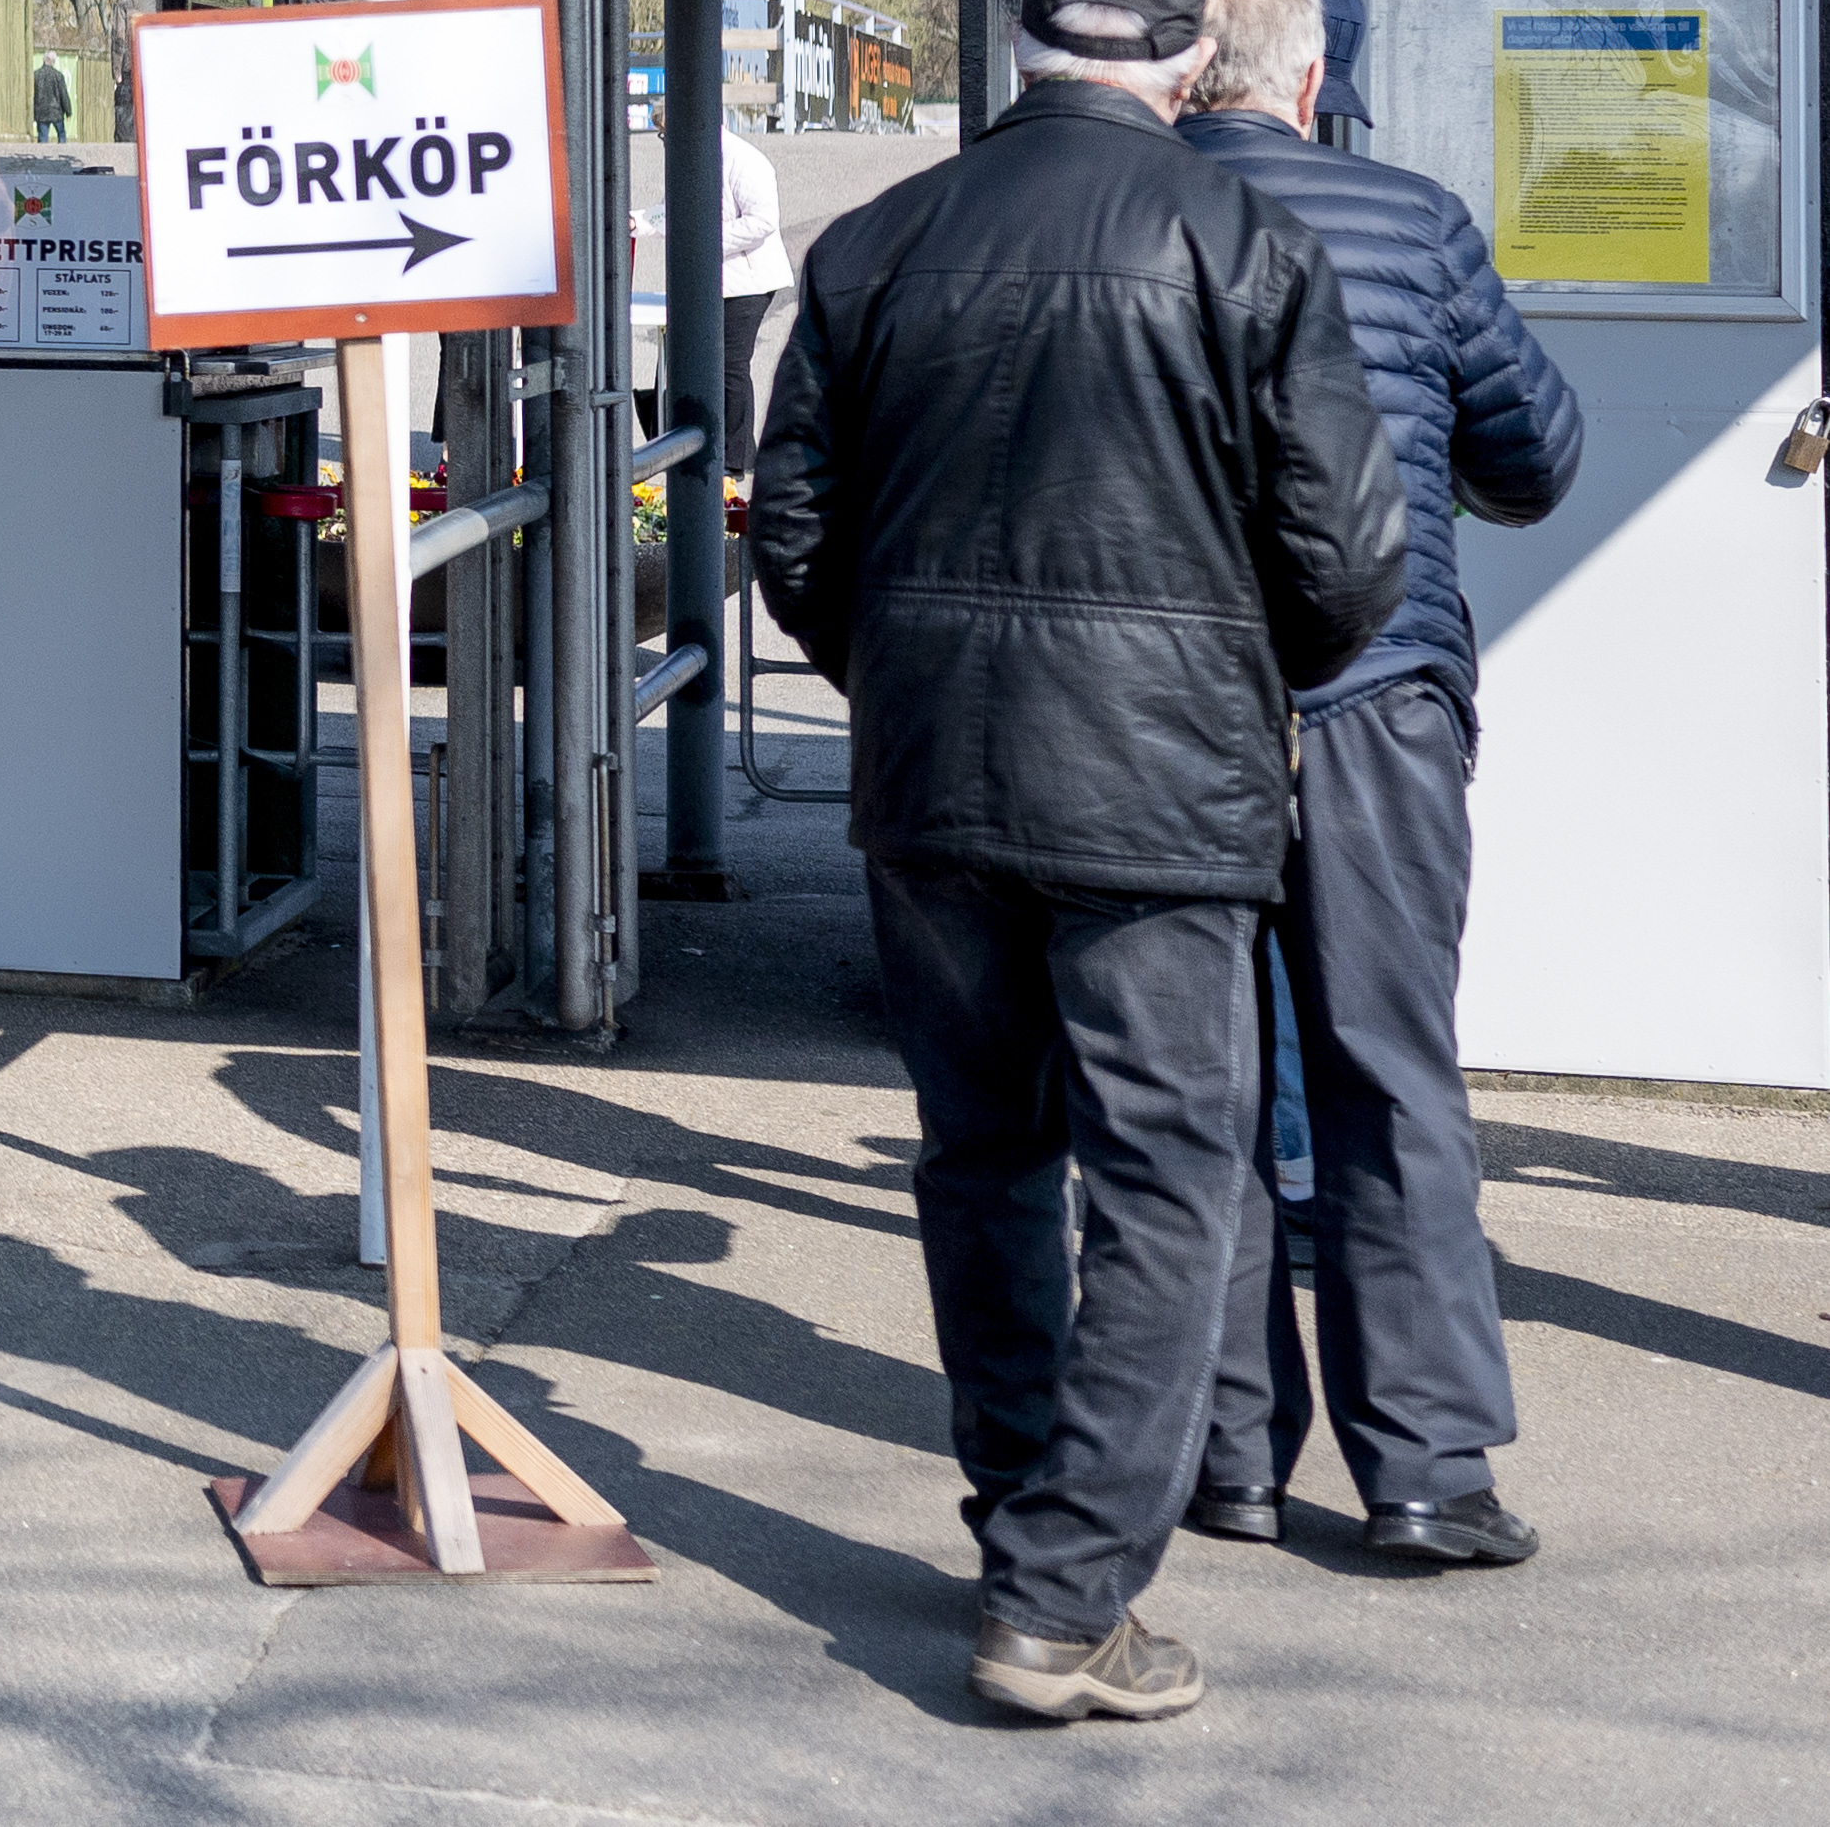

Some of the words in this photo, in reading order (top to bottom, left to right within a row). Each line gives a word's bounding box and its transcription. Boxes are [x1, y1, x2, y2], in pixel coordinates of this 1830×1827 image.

[794, 23, 835, 117] mplicity
[185, 115, 512, 210] FÖRKÖP
[55, 269, 111, 283] STÅPLATS
